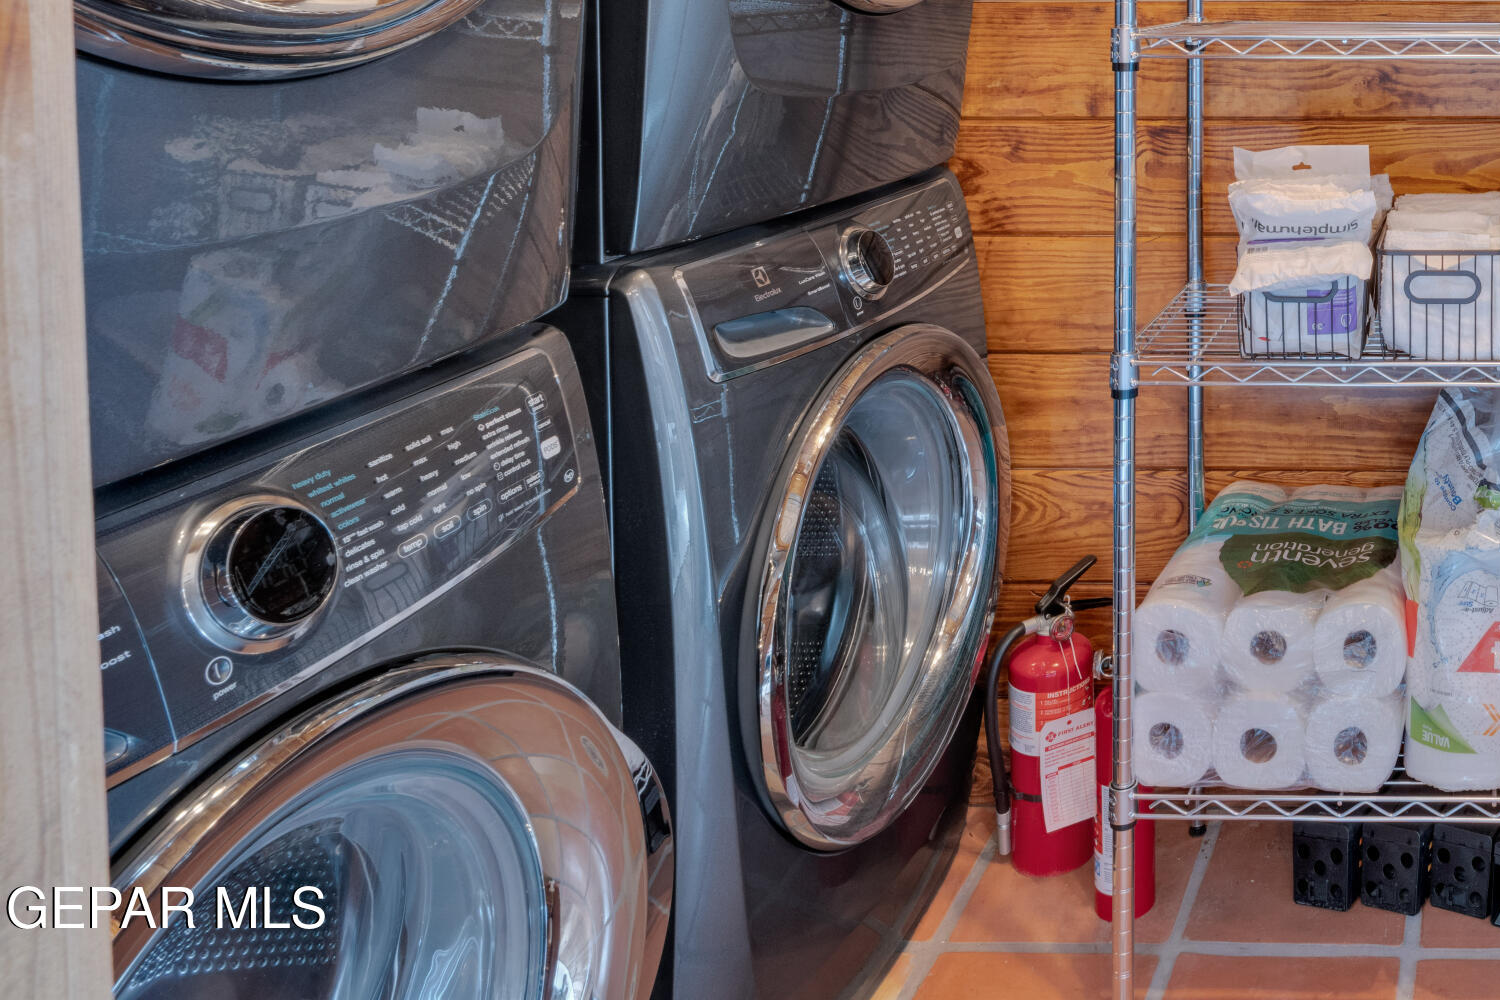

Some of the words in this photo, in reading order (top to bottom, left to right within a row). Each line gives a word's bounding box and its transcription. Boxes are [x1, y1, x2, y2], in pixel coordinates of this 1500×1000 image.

[754, 287, 782, 303] Electrolux
[527, 393, 544, 407] start
[291, 476, 315, 490] heavy
[314, 469, 332, 481] duty
[307, 483, 334, 498] whitest
[332, 473, 357, 487] whites
[376, 473, 389, 483] hot
[500, 485, 522, 500] options
[1440, 485, 1457, 511] Compare
[1443, 473, 1463, 505] Bounty
[320, 492, 346, 508] normal
[390, 503, 406, 516] cold
[472, 503, 488, 517] spin
[1342, 510, 1391, 519] EXTRA
[337, 516, 361, 530] colors
[408, 514, 423, 526] cold
[1288, 517, 1348, 535] BATH
[345, 538, 376, 558] delicates
[402, 538, 423, 553] temp
[1255, 541, 1375, 559] generation
[345, 559, 364, 573] rinse
[369, 548, 386, 562] spin
[1250, 549, 1372, 569] seventh
[344, 573, 365, 588] clean
[363, 560, 389, 578] washer
[212, 681, 238, 701] power
[1057, 727, 1074, 738] FIRST
[1075, 720, 1095, 733] ALERT
[1422, 730, 1451, 748] VALUE
